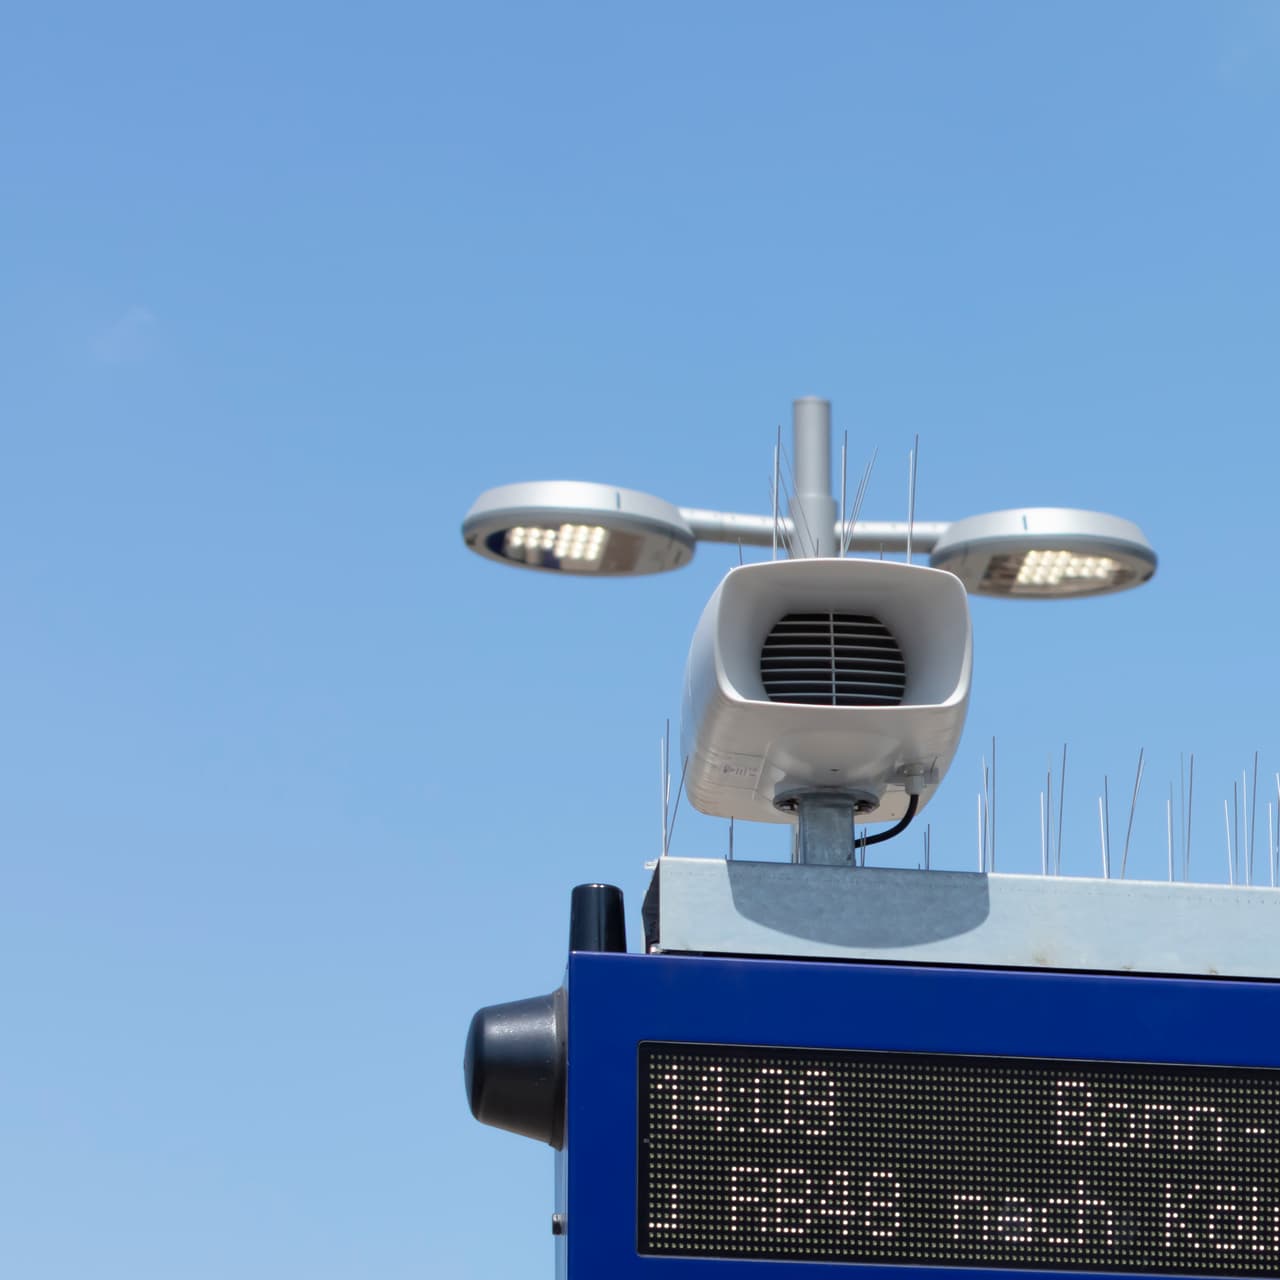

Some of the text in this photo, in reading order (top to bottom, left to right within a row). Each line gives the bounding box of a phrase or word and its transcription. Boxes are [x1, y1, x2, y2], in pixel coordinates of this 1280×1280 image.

[657, 1063, 835, 1136] 14:09
[730, 1165, 901, 1237] RB48
[952, 1179, 1113, 1245] nach
